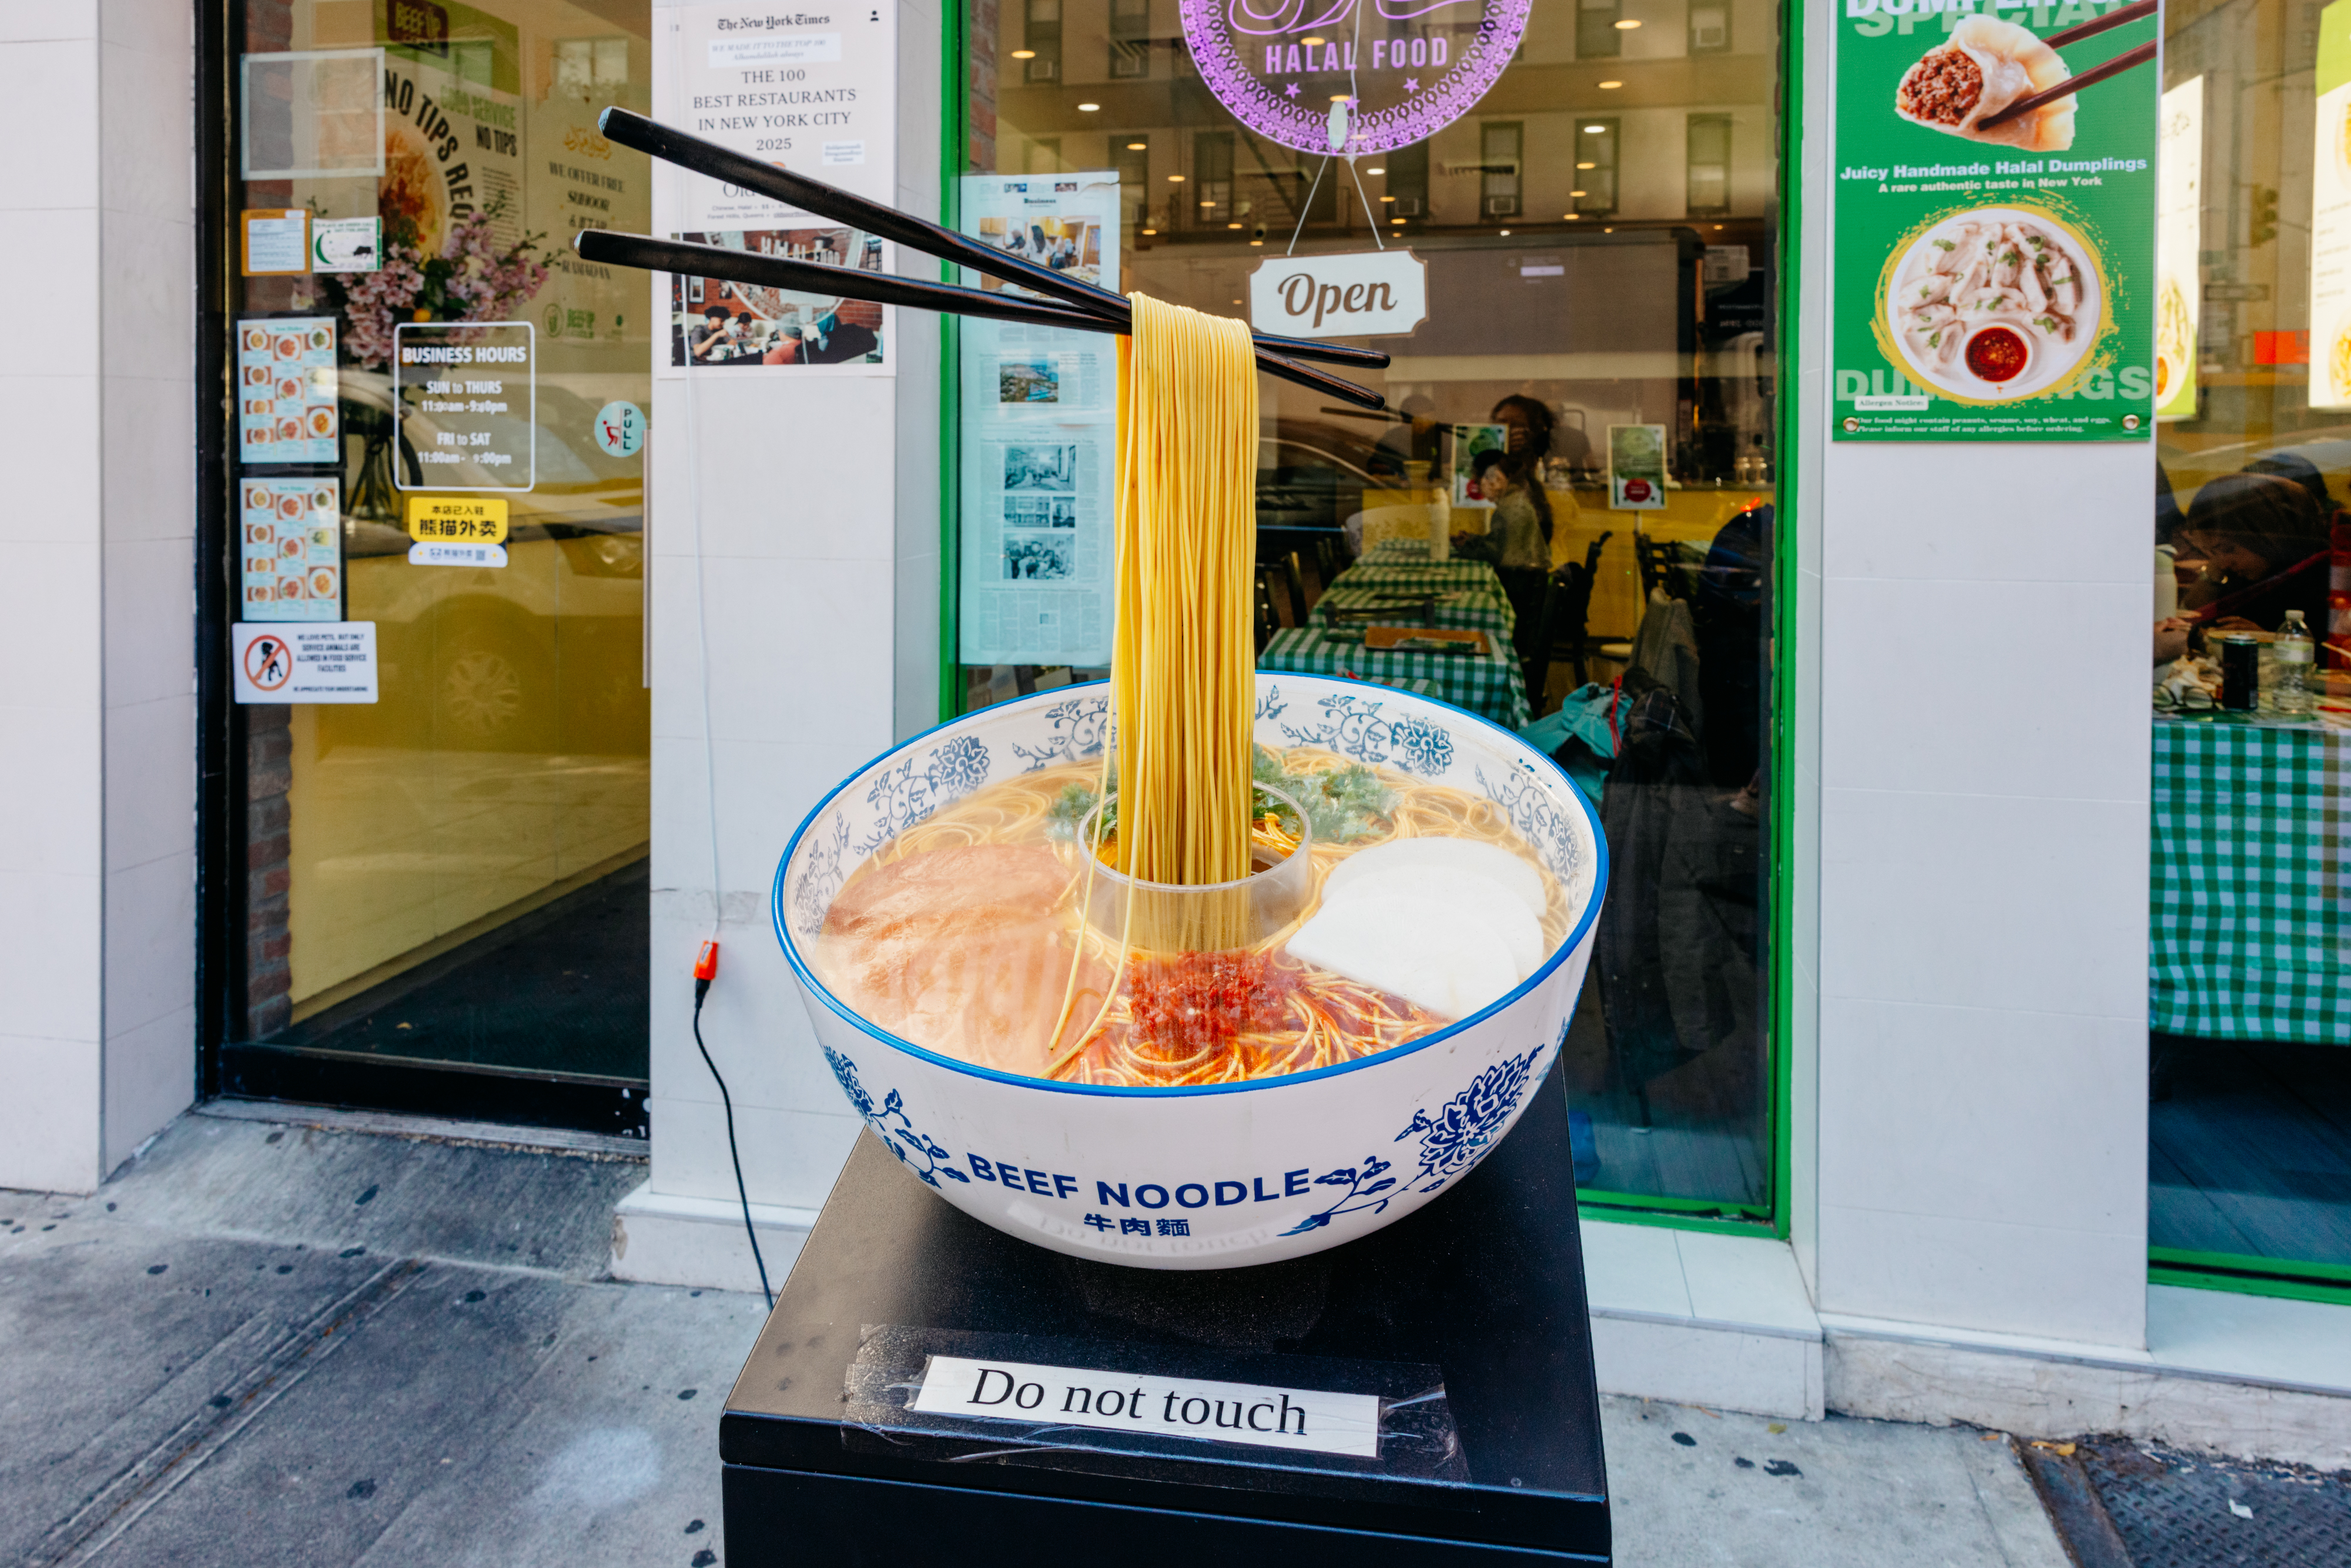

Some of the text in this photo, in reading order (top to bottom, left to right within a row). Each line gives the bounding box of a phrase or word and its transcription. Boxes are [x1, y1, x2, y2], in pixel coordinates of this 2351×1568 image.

[718, 14, 830, 30] The New York Times
[1266, 37, 1448, 74] HALAL FOOD
[741, 69, 806, 83] THE 100
[694, 88, 856, 109] BEST RESTAURANTS
[385, 69, 414, 116] NO
[416, 94, 459, 162] TIPS
[699, 112, 852, 131] IN NEW YORK CITY
[756, 138, 791, 150] 2025
[1840, 157, 2147, 181] Juicy Handmade Halal Dumplings
[1878, 176, 2102, 193] A rare authentic taste in New York
[1278, 273, 1398, 329] Open
[402, 346, 527, 363] BUSINESS HOURS
[426, 380, 502, 394] SUN to THURS
[1858, 398, 1893, 407] Allergen
[437, 432, 491, 445] FRI to SAT
[624, 408, 632, 450] PULL
[1978, 425, 2015, 434] allergies
[420, 518, 497, 537] 熊猫外卖
[344, 654, 366, 662] SERVICE
[967, 1152, 1310, 1209] BEEF NOODLE
[1084, 1213, 1191, 1237] 牛肉麵
[966, 1368, 1308, 1436] Do not touch
